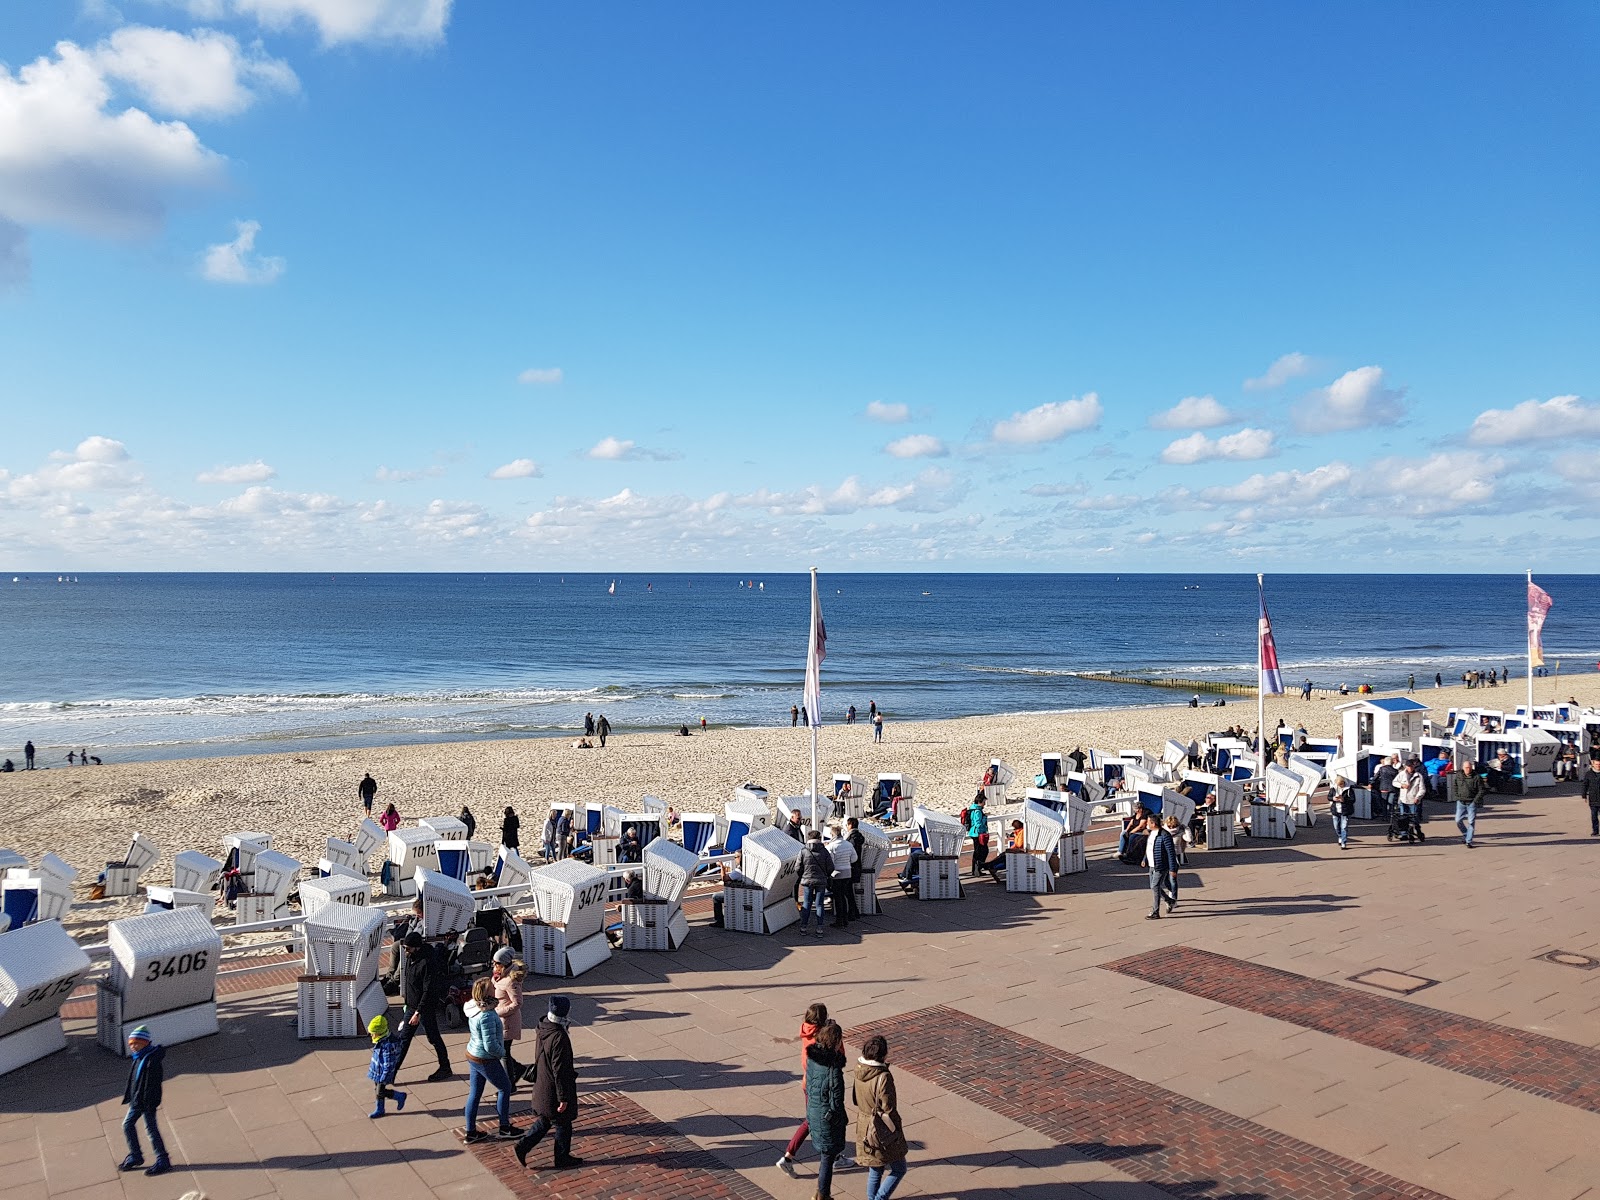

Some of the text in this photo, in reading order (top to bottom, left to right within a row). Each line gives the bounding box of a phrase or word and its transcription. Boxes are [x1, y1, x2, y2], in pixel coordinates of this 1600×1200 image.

[1531, 745, 1555, 757] 3424
[412, 843, 437, 859] 1013
[577, 882, 605, 910] 3472
[146, 950, 208, 982] 3406
